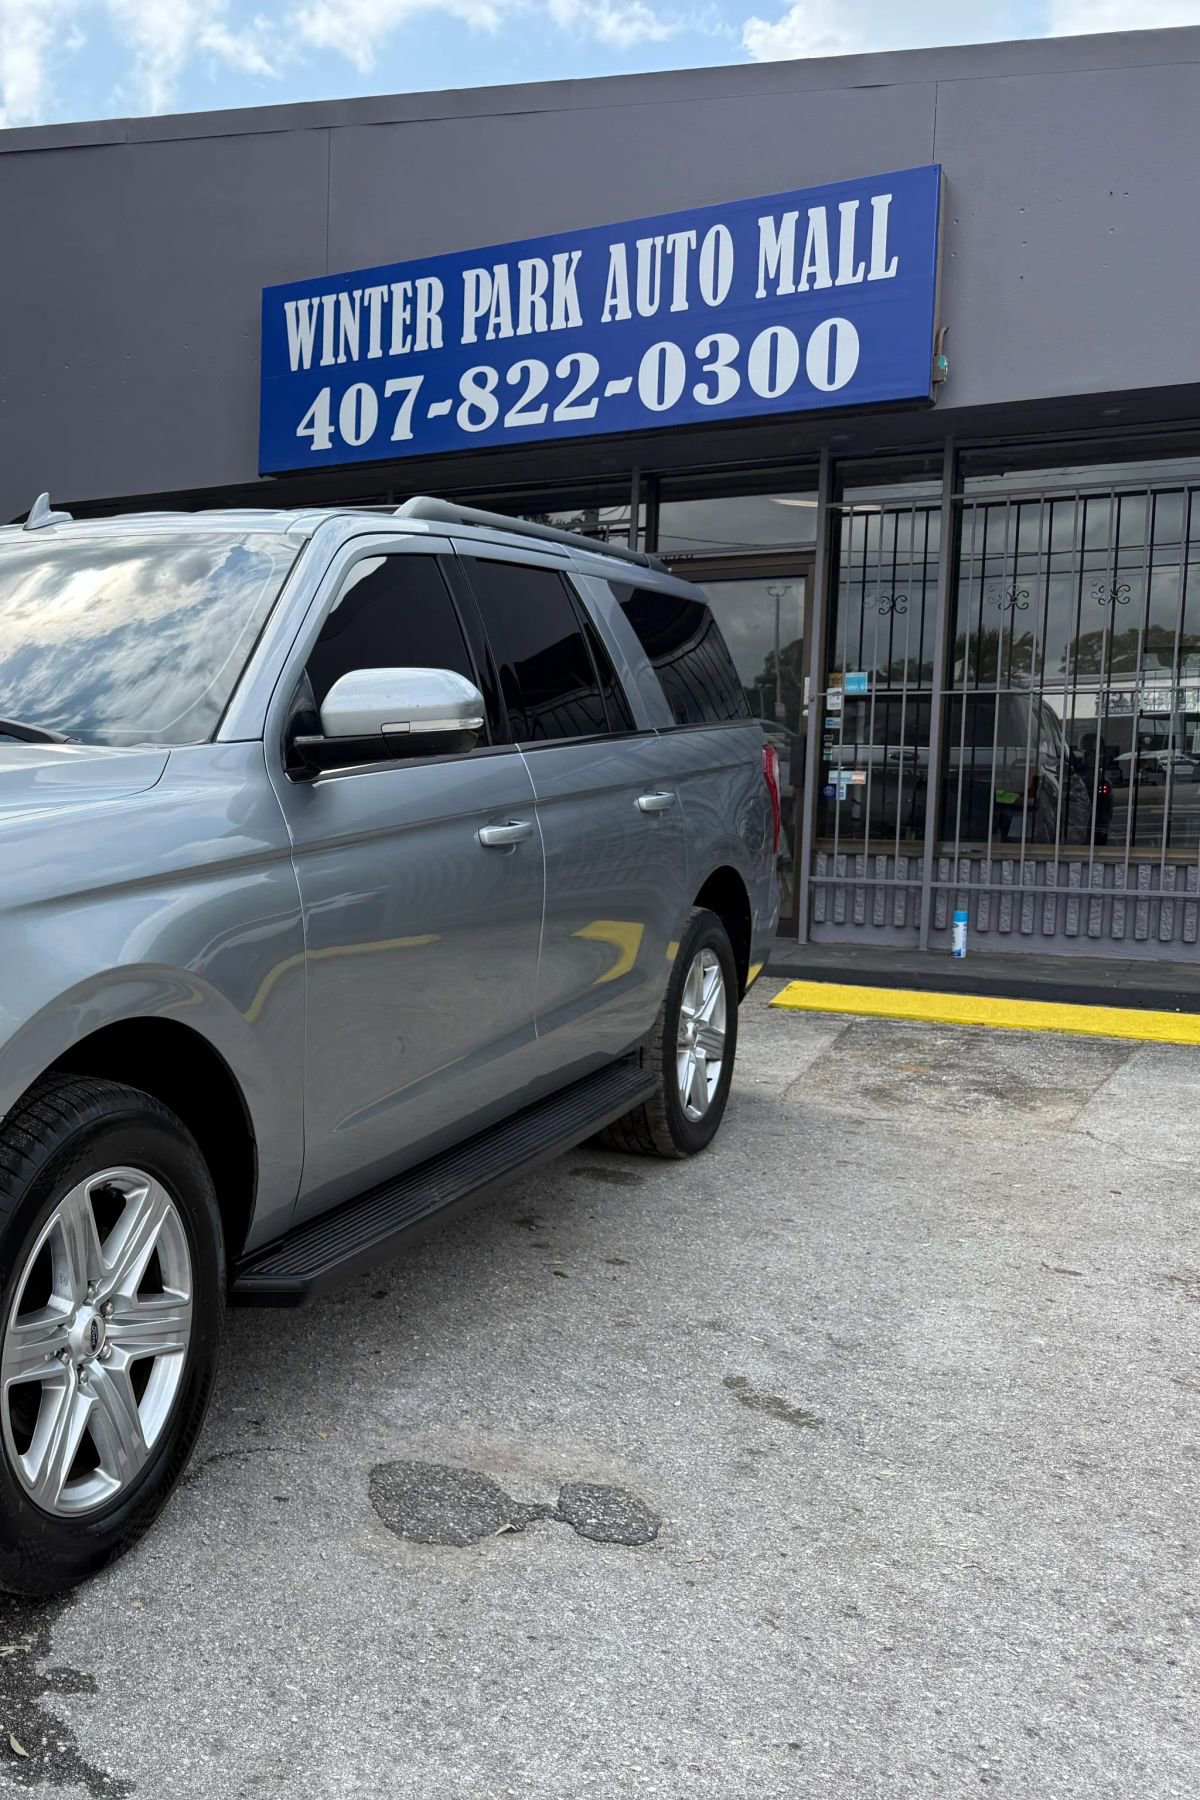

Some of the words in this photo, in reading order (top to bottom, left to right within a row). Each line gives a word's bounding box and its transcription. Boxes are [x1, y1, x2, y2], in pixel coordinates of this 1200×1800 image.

[284, 276, 444, 371] WINTER
[461, 250, 583, 345] PARK
[601, 224, 734, 323] AUTO
[755, 193, 899, 299] MALL
[296, 317, 860, 451] 407-822-0300
